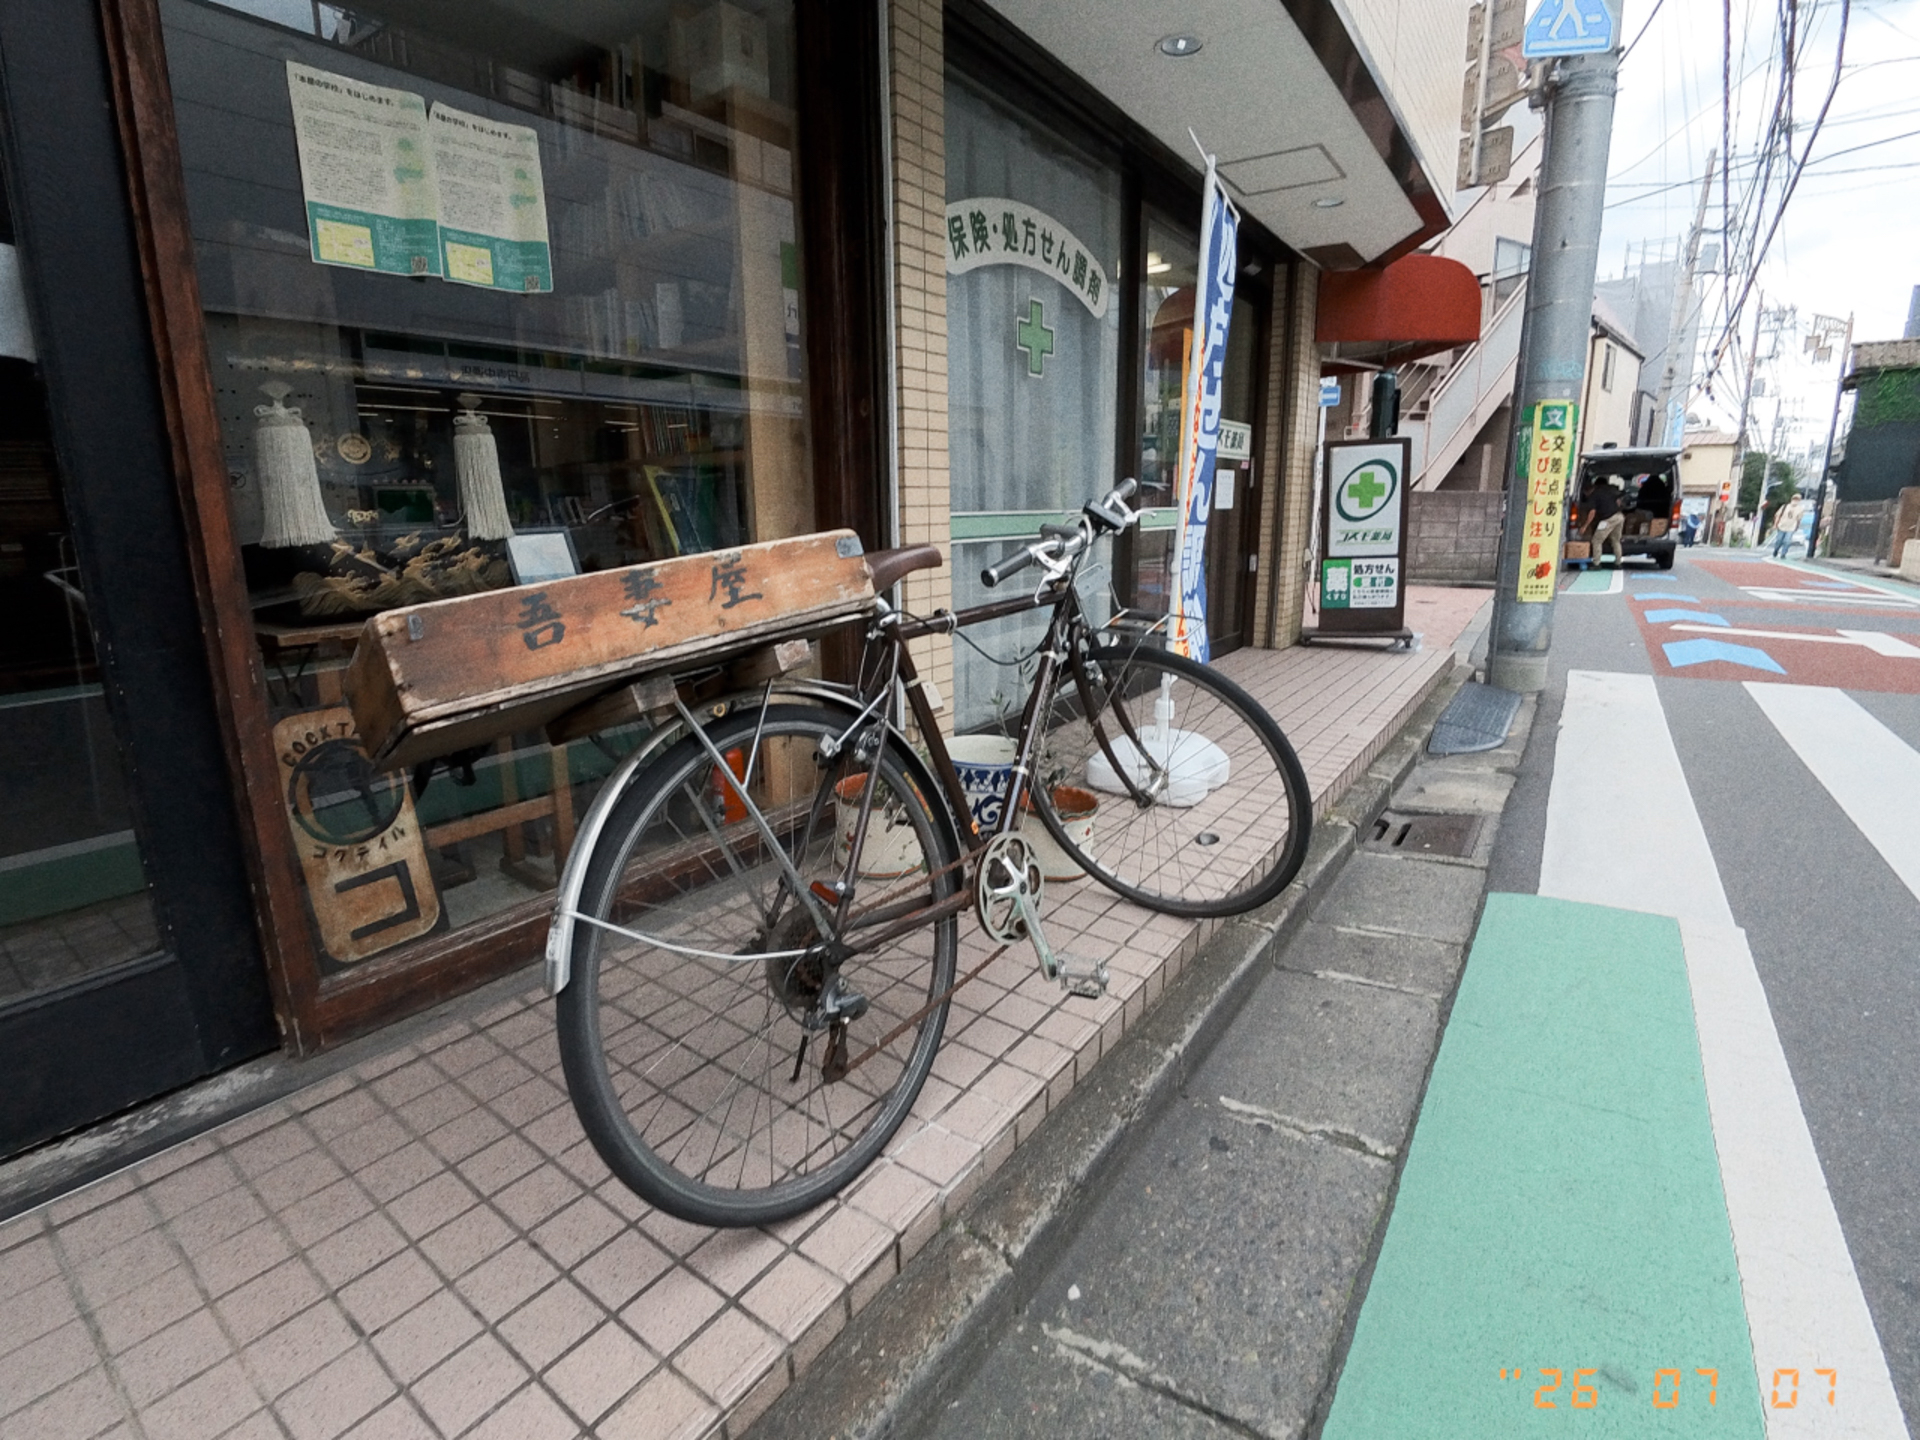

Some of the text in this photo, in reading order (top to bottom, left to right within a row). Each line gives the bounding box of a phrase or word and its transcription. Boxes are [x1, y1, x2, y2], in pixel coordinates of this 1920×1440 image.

[947, 208, 1102, 306] 保険・処方せん調剤
[1526, 434, 1552, 560] とびだし注意
[1545, 434, 1566, 538] 交差点あり
[1353, 563, 1395, 575] 処方せん
[313, 826, 406, 863] コクテイル
